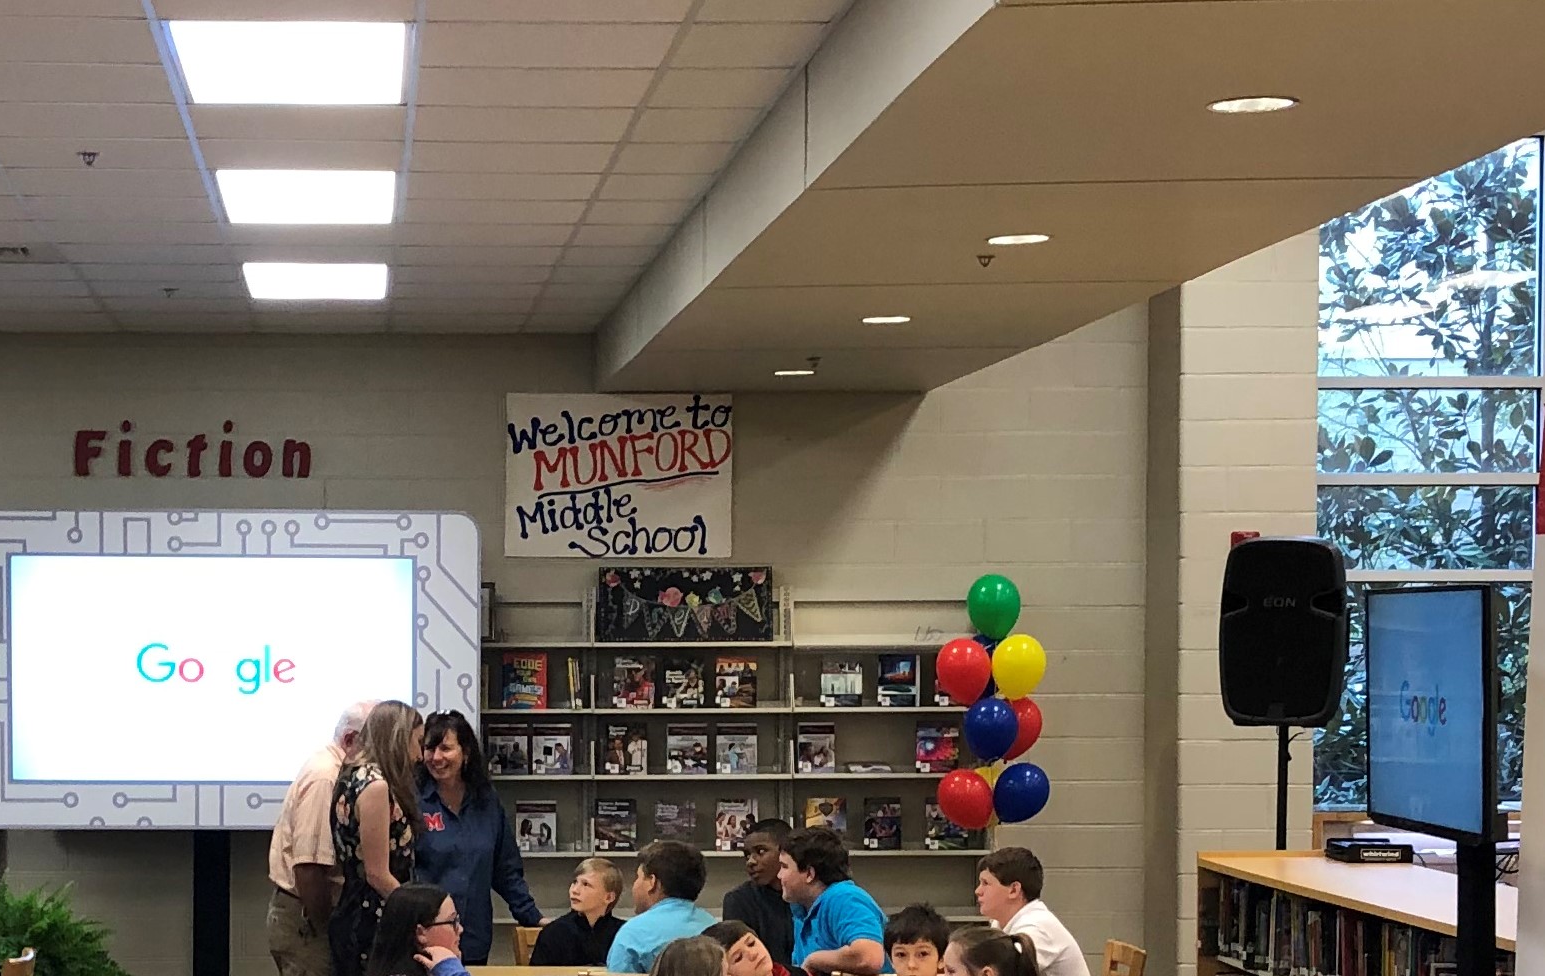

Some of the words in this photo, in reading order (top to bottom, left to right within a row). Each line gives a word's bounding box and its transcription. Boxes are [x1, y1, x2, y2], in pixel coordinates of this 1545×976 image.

[74, 420, 311, 478] Fiction
[508, 405, 681, 454] Welcome
[686, 395, 732, 430] to
[533, 429, 732, 491] MUNFORD
[516, 488, 637, 539] Middle
[568, 515, 707, 558] School
[136, 642, 296, 694] Gogle
[1400, 680, 1446, 736] Google
